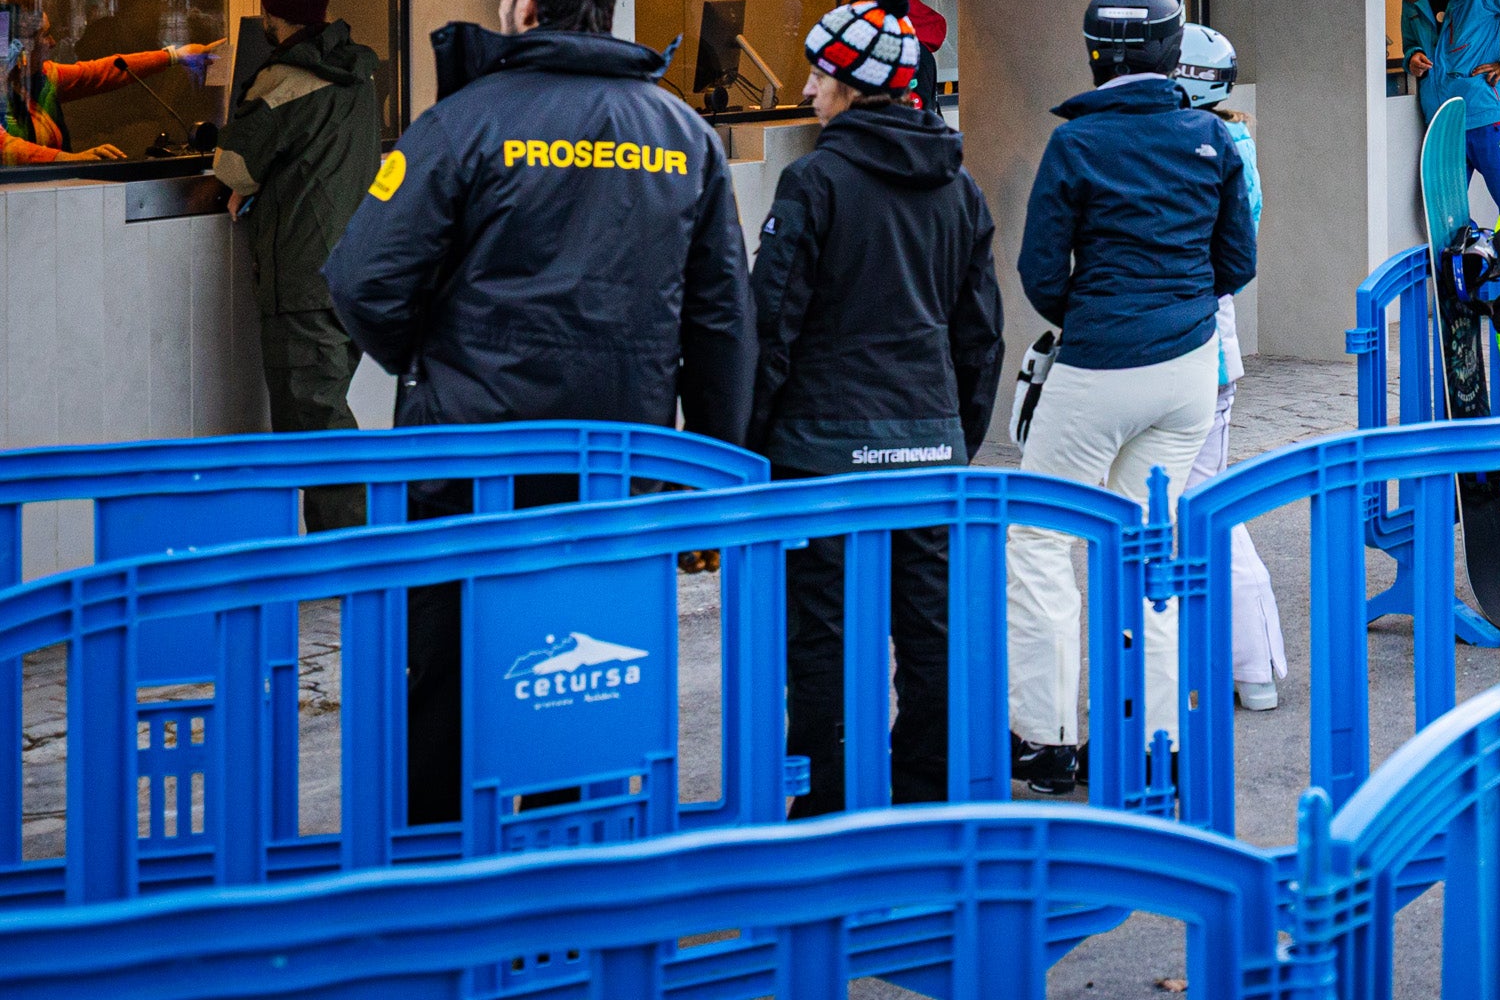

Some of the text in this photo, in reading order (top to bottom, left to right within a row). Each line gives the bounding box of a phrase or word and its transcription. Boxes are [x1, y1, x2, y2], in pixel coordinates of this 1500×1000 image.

[503, 139, 688, 175] PROSEGUR
[851, 443, 953, 464] sierranevada
[515, 665, 641, 699] cetursa
